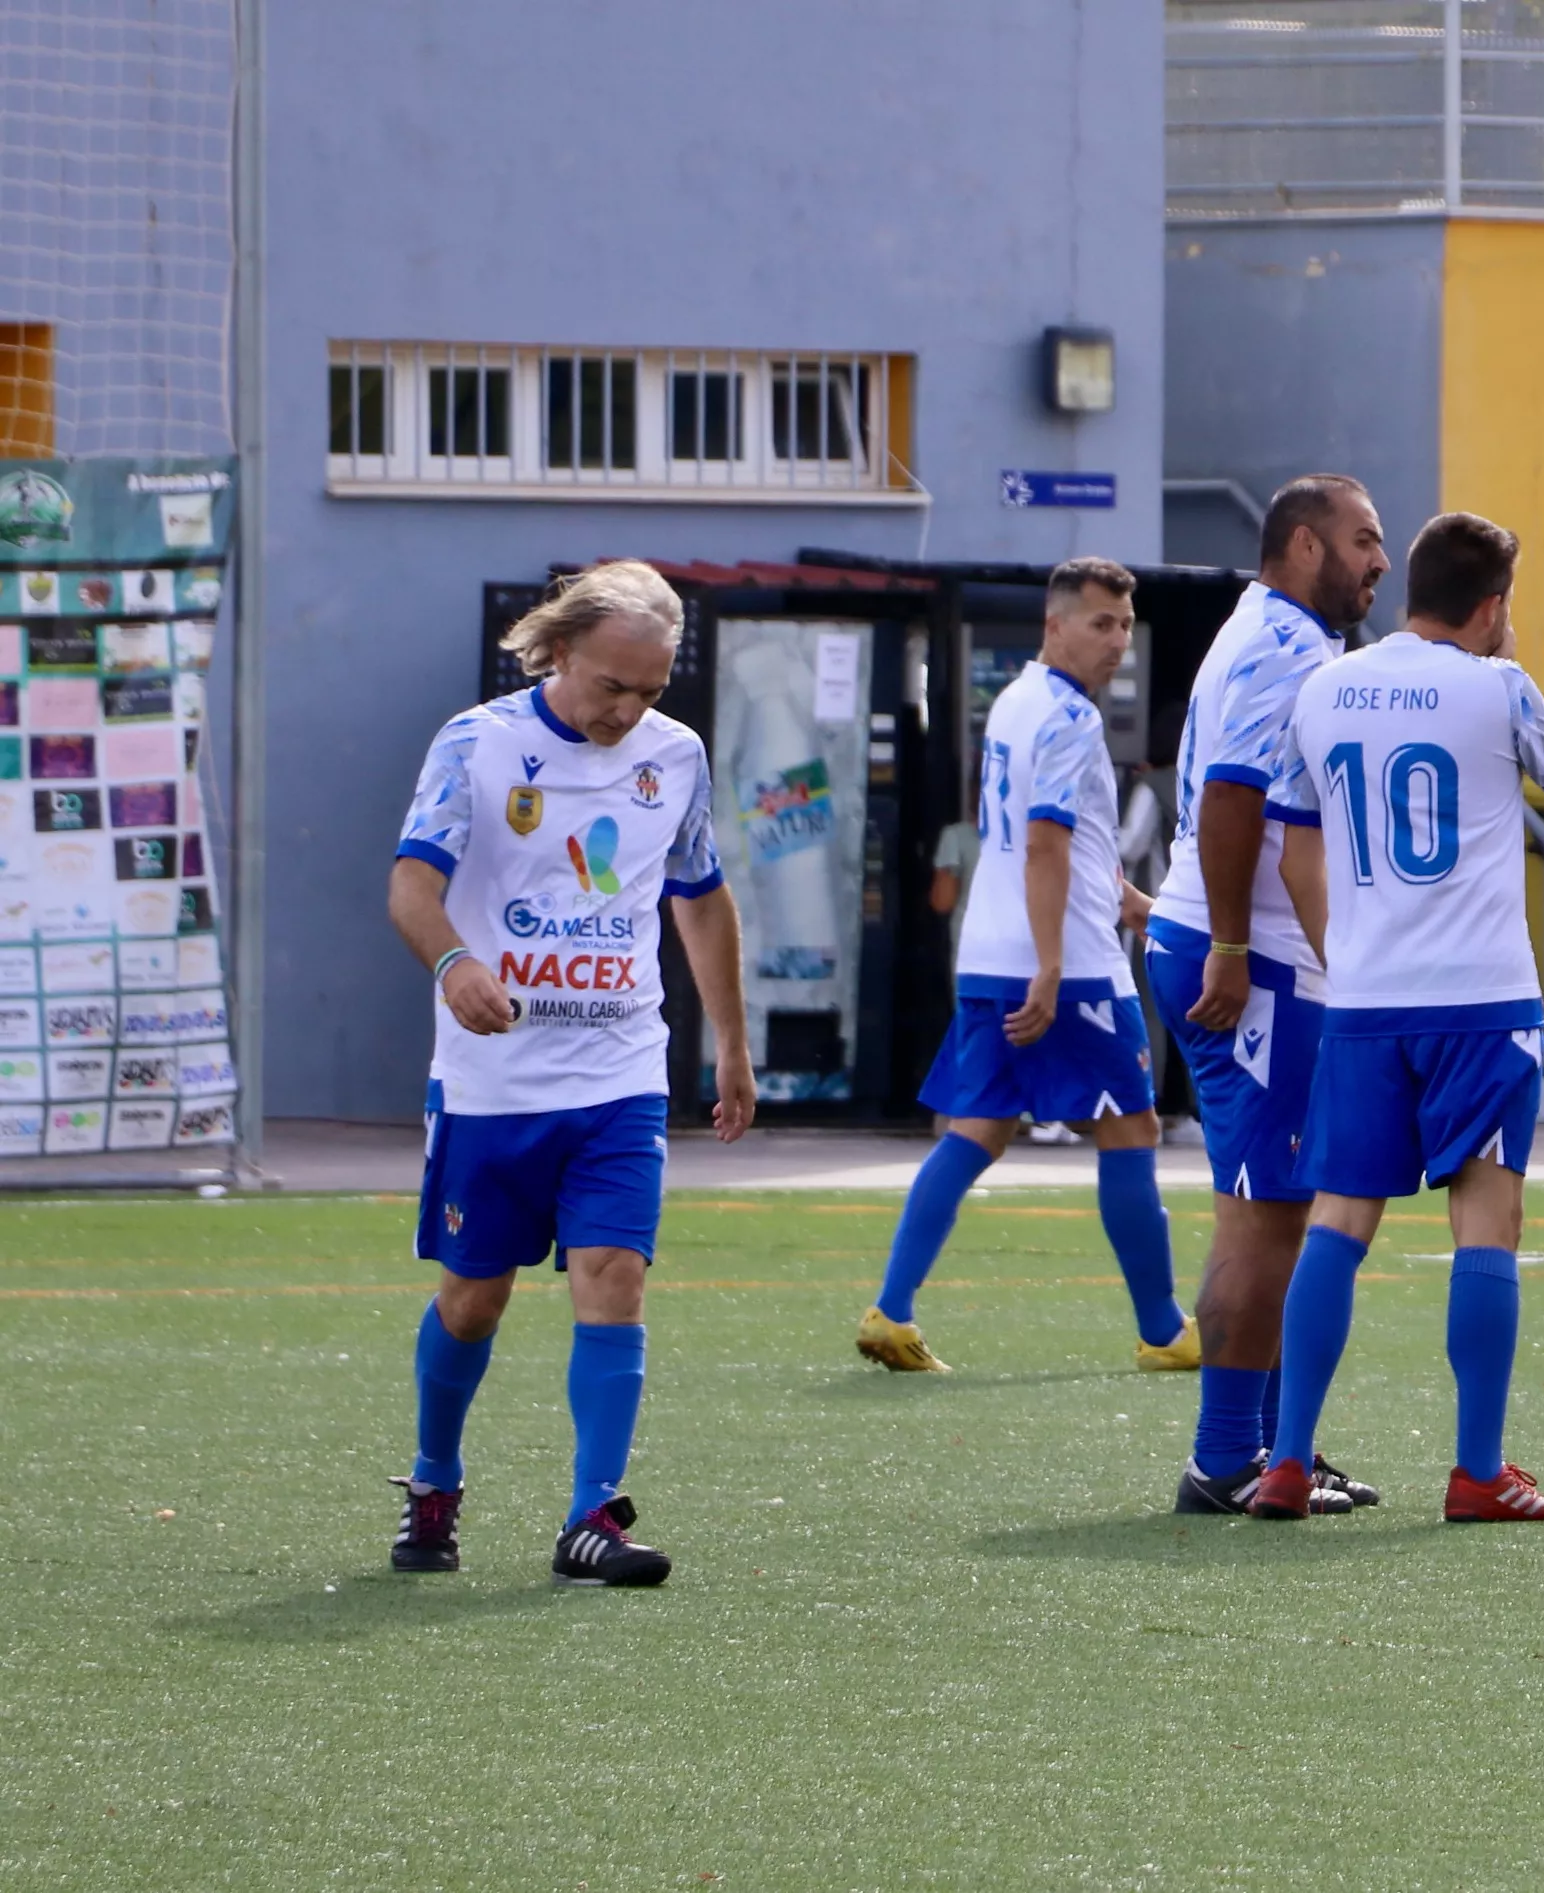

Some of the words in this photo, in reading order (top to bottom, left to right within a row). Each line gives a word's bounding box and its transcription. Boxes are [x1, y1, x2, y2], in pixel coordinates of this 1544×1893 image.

[1333, 687, 1382, 710] JOSE
[1389, 687, 1439, 710] PINO
[1323, 741, 1460, 887] 10
[499, 951, 636, 990] NACEX
[529, 998, 585, 1019] IMANOL
